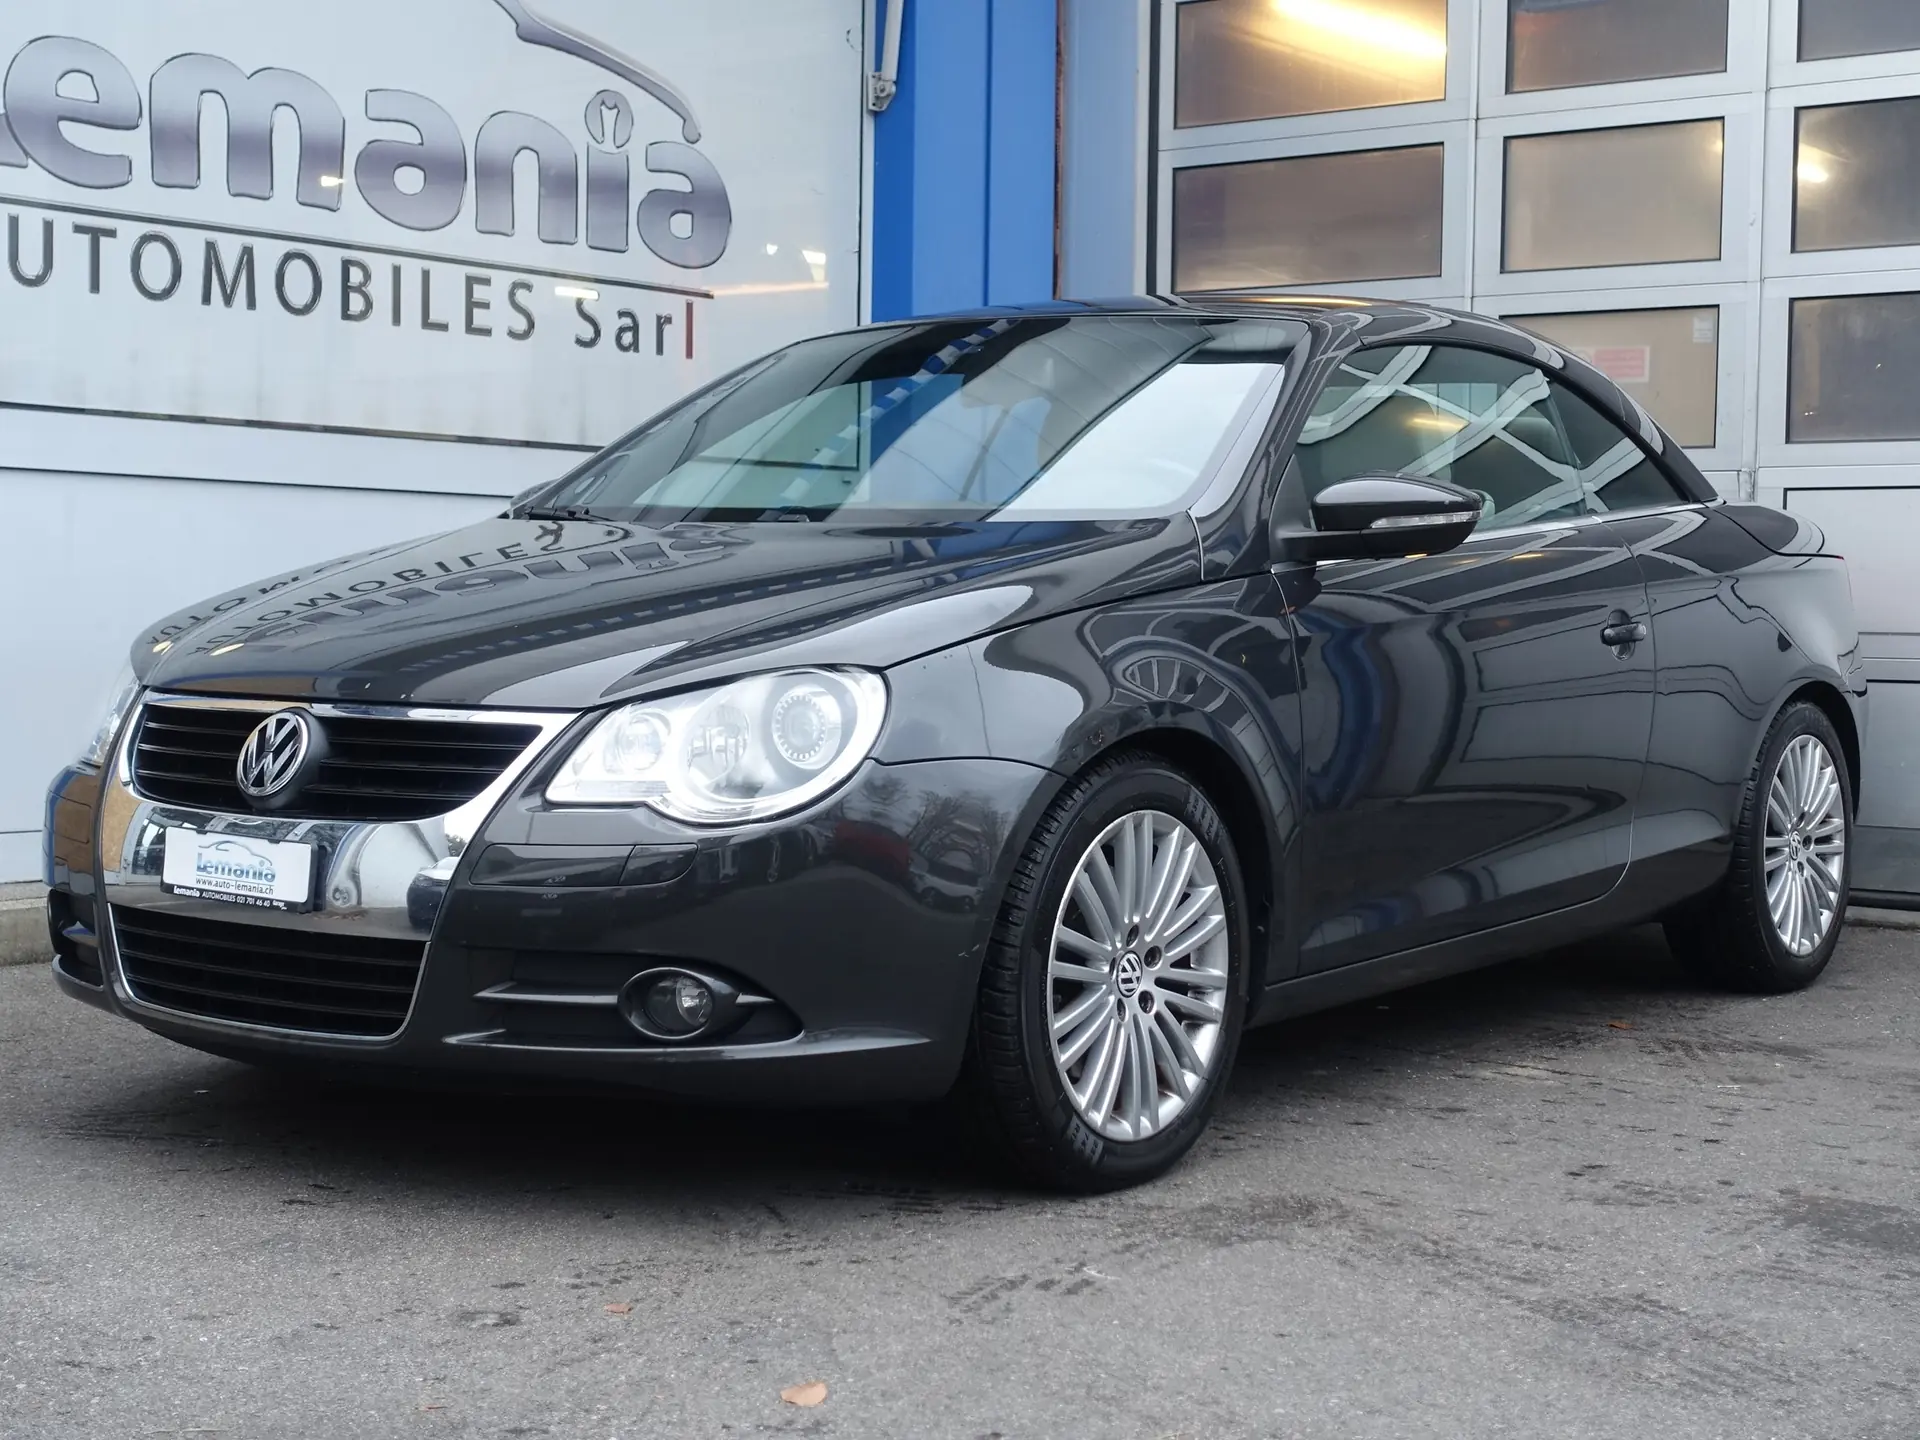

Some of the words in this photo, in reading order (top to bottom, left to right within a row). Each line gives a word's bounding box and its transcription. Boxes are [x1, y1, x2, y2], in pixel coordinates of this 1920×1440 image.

[0, 35, 732, 268] emania
[573, 287, 694, 360] Sarl
[195, 876, 275, 896] www.auto-lemania.ch
[201, 890, 236, 903] AUTOMOBILES
